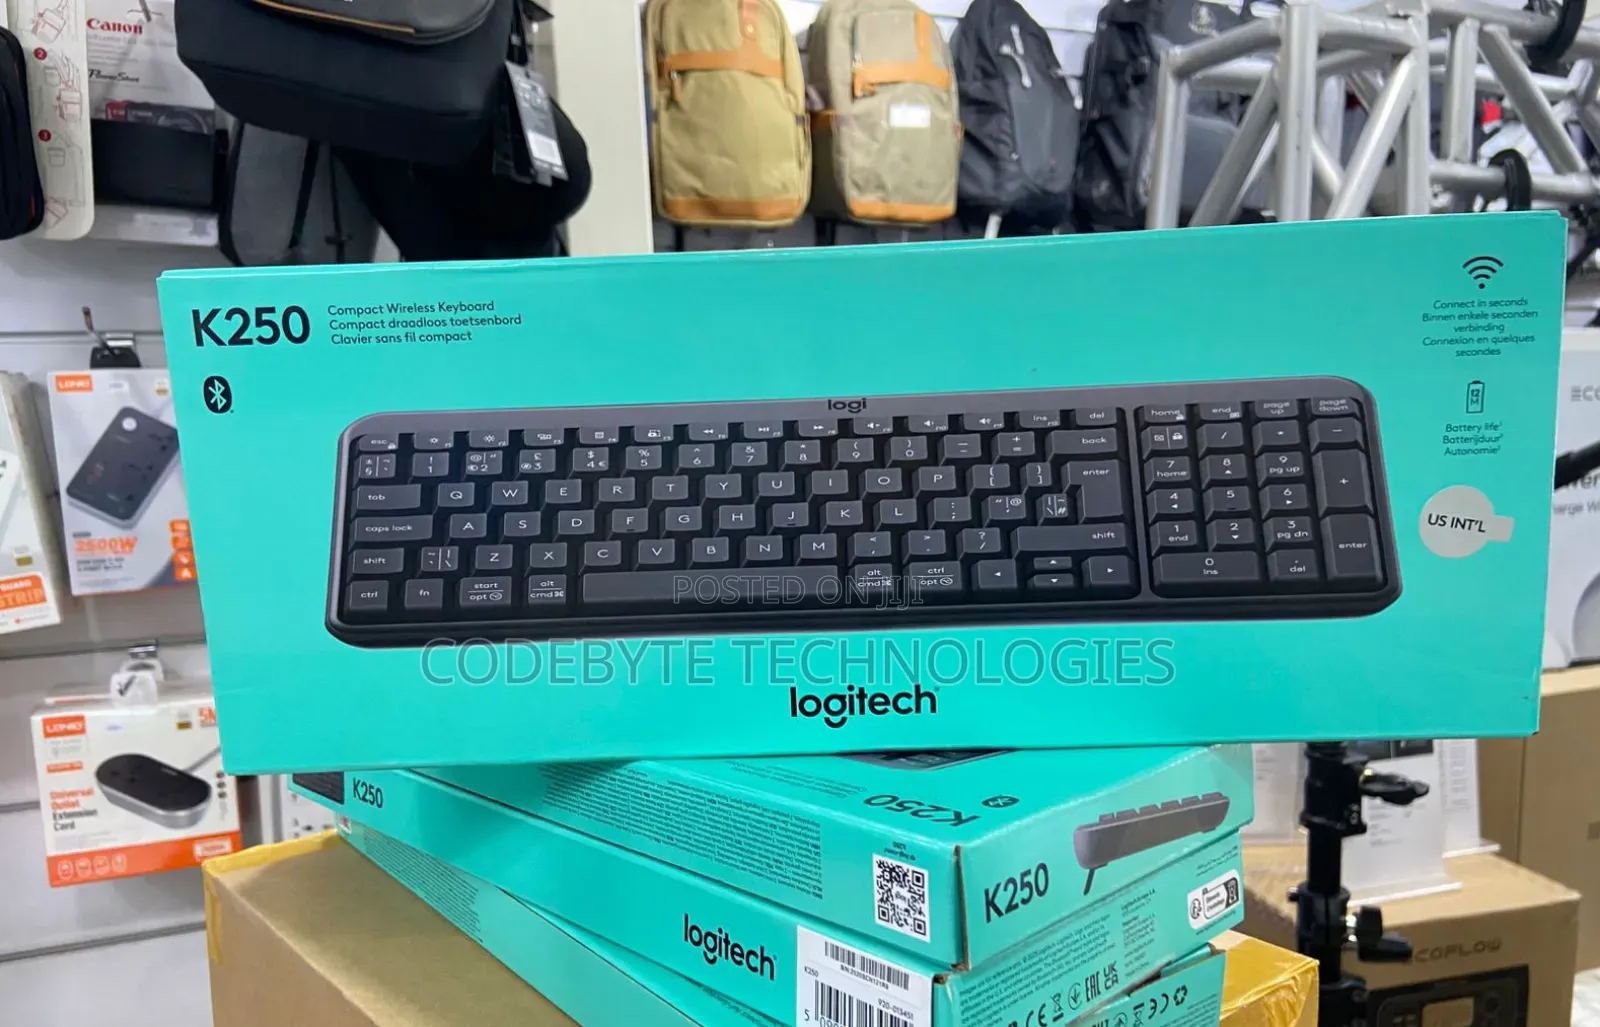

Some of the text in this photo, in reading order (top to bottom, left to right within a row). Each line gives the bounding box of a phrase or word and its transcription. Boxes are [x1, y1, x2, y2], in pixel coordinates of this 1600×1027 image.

[86, 17, 143, 36] Canon
[1433, 296, 1529, 310] Connect in seconds
[327, 299, 495, 317] Compact Wireless Keyboard
[1422, 309, 1539, 322] Binnen enkele seconden
[191, 304, 311, 347] K250
[329, 314, 523, 332] Compact draadloos toetsenbord
[1453, 322, 1505, 334] verbinding
[330, 330, 473, 346] Clavier sans fil compact
[1422, 334, 1536, 347] Connexion en quelques
[1455, 347, 1502, 357] secondes
[827, 397, 867, 414] logi
[1263, 401, 1290, 409] page
[1319, 399, 1347, 407] page
[1089, 411, 1105, 419] del
[1151, 408, 1180, 417] home
[1211, 407, 1231, 415] end
[1270, 408, 1285, 416] up
[1033, 414, 1048, 422] ins
[1445, 423, 1482, 433] Battery
[1081, 436, 1107, 444] back
[799, 453, 807, 461] 8
[852, 451, 860, 459] 9
[905, 449, 914, 458] 0
[640, 459, 648, 467] 5
[693, 456, 701, 465] 6
[747, 455, 754, 463] 7
[1222, 457, 1232, 466] 8
[1278, 455, 1289, 464] 9
[480, 464, 488, 472] 2
[533, 462, 542, 471] 3
[586, 460, 595, 468] 4
[1167, 460, 1176, 469] 7
[427, 465, 433, 474] 1
[1082, 468, 1110, 476] enter
[1156, 469, 1187, 478] home
[1269, 465, 1301, 475] pg up
[877, 476, 890, 485] O
[934, 474, 943, 483] P
[665, 484, 675, 493] T
[718, 481, 729, 491] Y
[772, 480, 783, 489] U
[502, 488, 519, 498] W
[559, 486, 568, 496] E
[613, 485, 622, 495] R
[1226, 490, 1235, 499] 5
[1283, 488, 1293, 497] 6
[367, 493, 385, 501] tab
[450, 490, 463, 500] Q
[1169, 492, 1179, 501] 4
[787, 511, 795, 520] J
[840, 509, 850, 518] K
[894, 507, 903, 517] L
[571, 517, 583, 527] D
[627, 516, 634, 525] F
[678, 514, 690, 523] G
[732, 513, 743, 522] H
[1427, 512, 1448, 527] US
[365, 523, 413, 534] caps lock
[462, 521, 475, 531] A
[518, 519, 527, 529] S
[1229, 523, 1239, 531] 2
[1287, 520, 1296, 529] 3
[1091, 530, 1116, 540] shift
[1168, 534, 1189, 542] end
[1277, 530, 1309, 540] pg dn
[706, 545, 716, 555] B
[759, 543, 771, 553] N
[812, 542, 826, 551] M
[1338, 541, 1367, 550] enter
[543, 551, 555, 561] X
[597, 549, 608, 559] C
[651, 547, 663, 557] V
[363, 556, 386, 565] shift
[490, 552, 500, 562] Z
[867, 568, 881, 577] alt
[927, 566, 945, 575] ctrl
[1203, 568, 1218, 576] ins
[1289, 565, 1306, 574] del
[473, 581, 498, 590] start
[540, 579, 555, 588] alt
[920, 578, 938, 587] opt
[360, 590, 378, 599] ctrl
[419, 588, 430, 597] fn
[469, 592, 487, 602] opt
[530, 591, 553, 599] cmd
[789, 684, 938, 730] logitech
[352, 777, 384, 809] K250
[52, 809, 98, 821] Extension
[863, 794, 981, 828] K250
[53, 820, 76, 831] Cord
[984, 862, 1049, 924] K250
[683, 912, 777, 981] logitech
[803, 965, 819, 978] K250
[1103, 960, 1118, 976] UK
[1104, 973, 1119, 991] CA
[804, 1009, 810, 1022] 5
